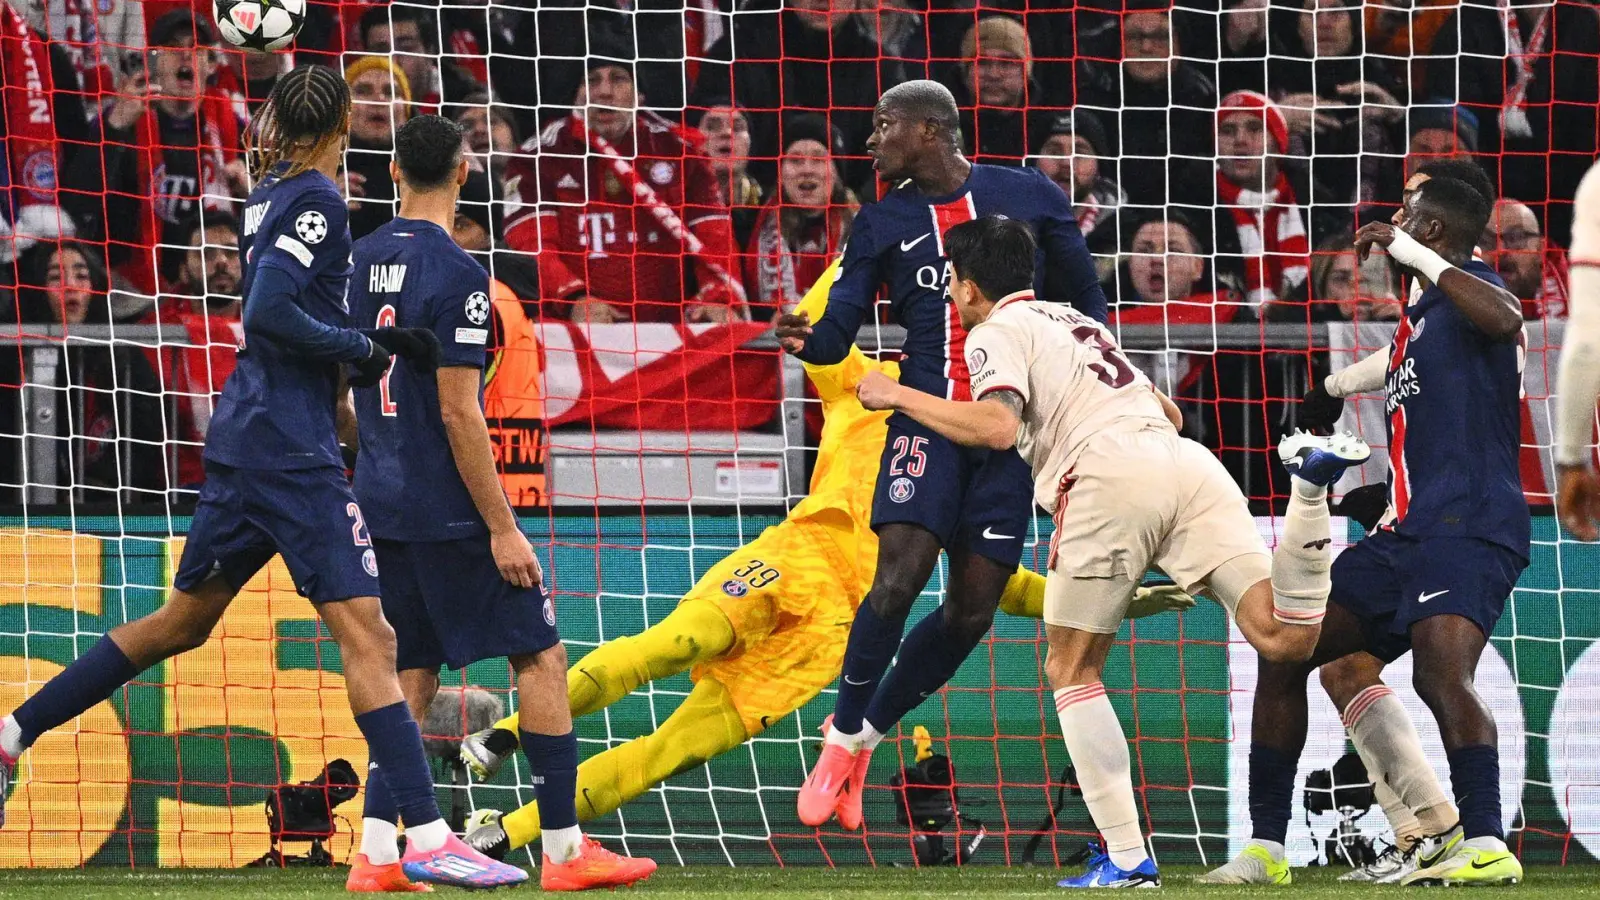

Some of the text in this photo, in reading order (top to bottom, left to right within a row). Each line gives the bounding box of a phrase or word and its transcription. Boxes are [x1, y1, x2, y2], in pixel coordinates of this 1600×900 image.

[1071, 325, 1135, 389] 3
[889, 435, 930, 477] 25
[346, 502, 373, 547] 2
[733, 559, 780, 588] 39
